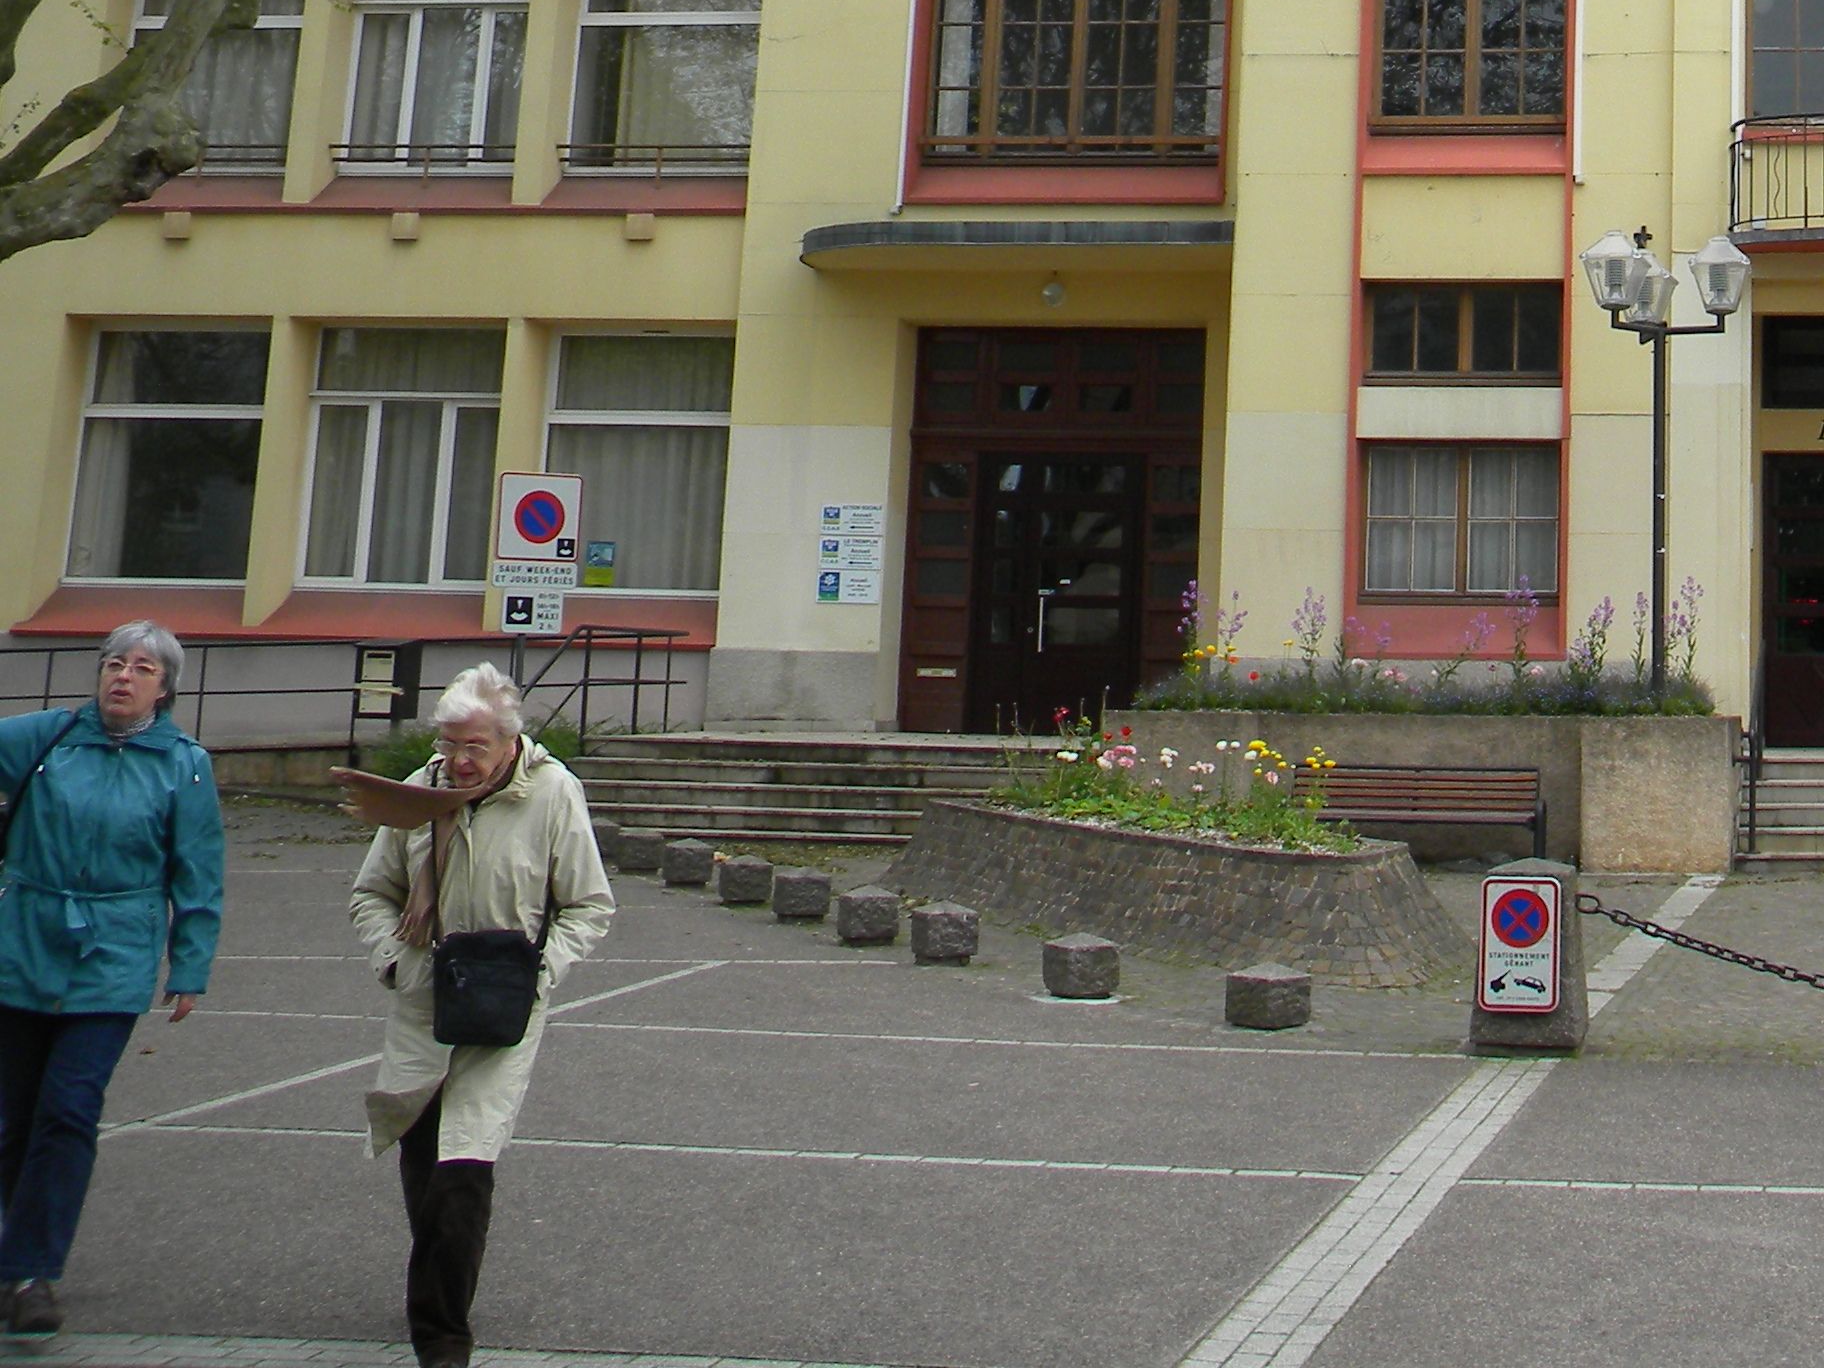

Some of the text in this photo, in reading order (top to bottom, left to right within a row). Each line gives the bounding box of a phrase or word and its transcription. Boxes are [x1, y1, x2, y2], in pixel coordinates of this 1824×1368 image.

[499, 564, 572, 575] SAUF WEEK-END
[495, 575, 506, 583] ET
[509, 575, 538, 583] JOURS
[539, 622, 544, 630] 2
[1488, 952, 1550, 960] STATIONNEMENT
